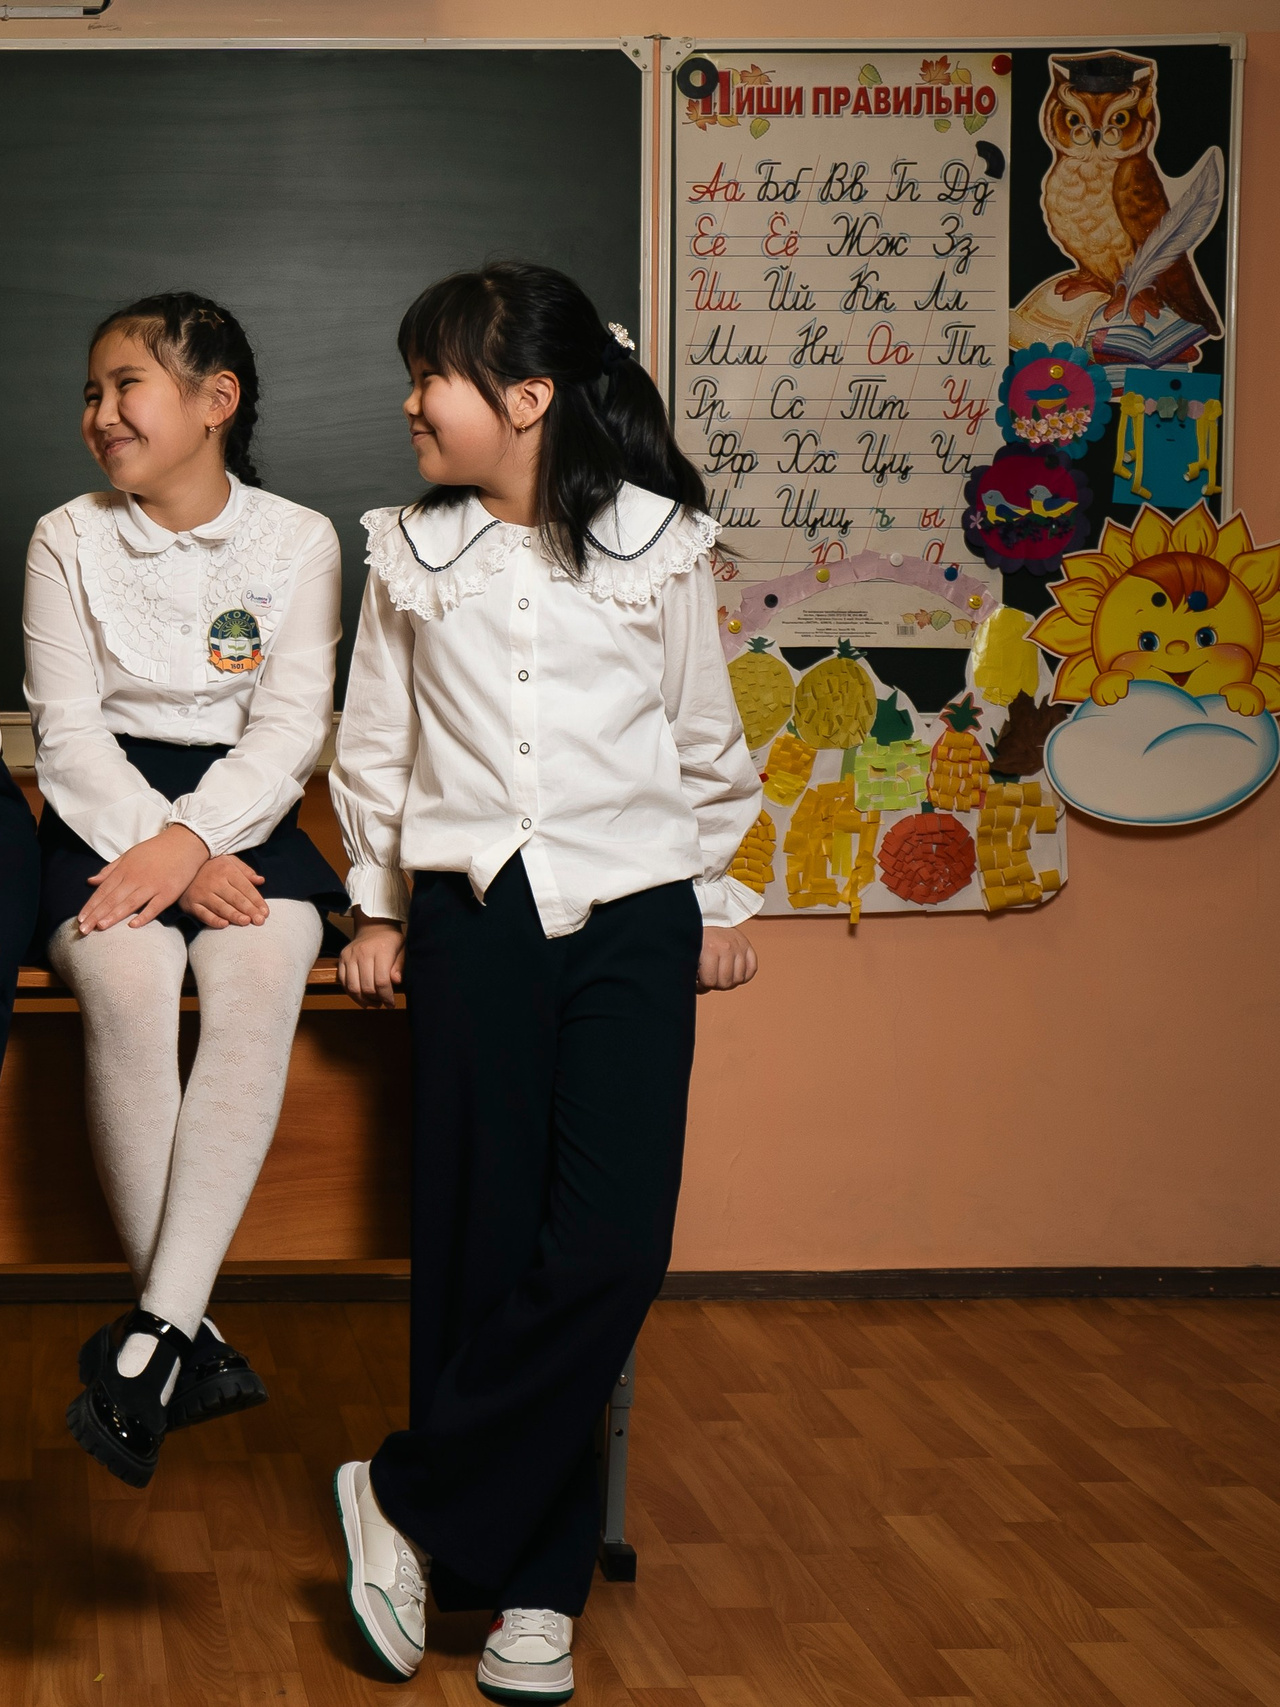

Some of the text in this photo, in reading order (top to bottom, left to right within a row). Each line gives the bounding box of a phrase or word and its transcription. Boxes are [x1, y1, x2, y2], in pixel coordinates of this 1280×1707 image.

[812, 85, 997, 116] ПРАВИЛЬНО
[688, 161, 995, 216] Аа Бб Вв Гг Дд
[692, 211, 980, 275] Ее Ёё Жж Зз
[689, 265, 968, 311] Ии Йй Кк Лл
[691, 325, 992, 365] Мм Нн Оо Пп
[686, 379, 990, 435] Рр Сс Тт Уу
[704, 433, 976, 489] Фф Хх Цц Чч
[776, 488, 853, 537] Щщ
[921, 508, 946, 528] ы
[214, 611, 256, 629] ШКОЛА
